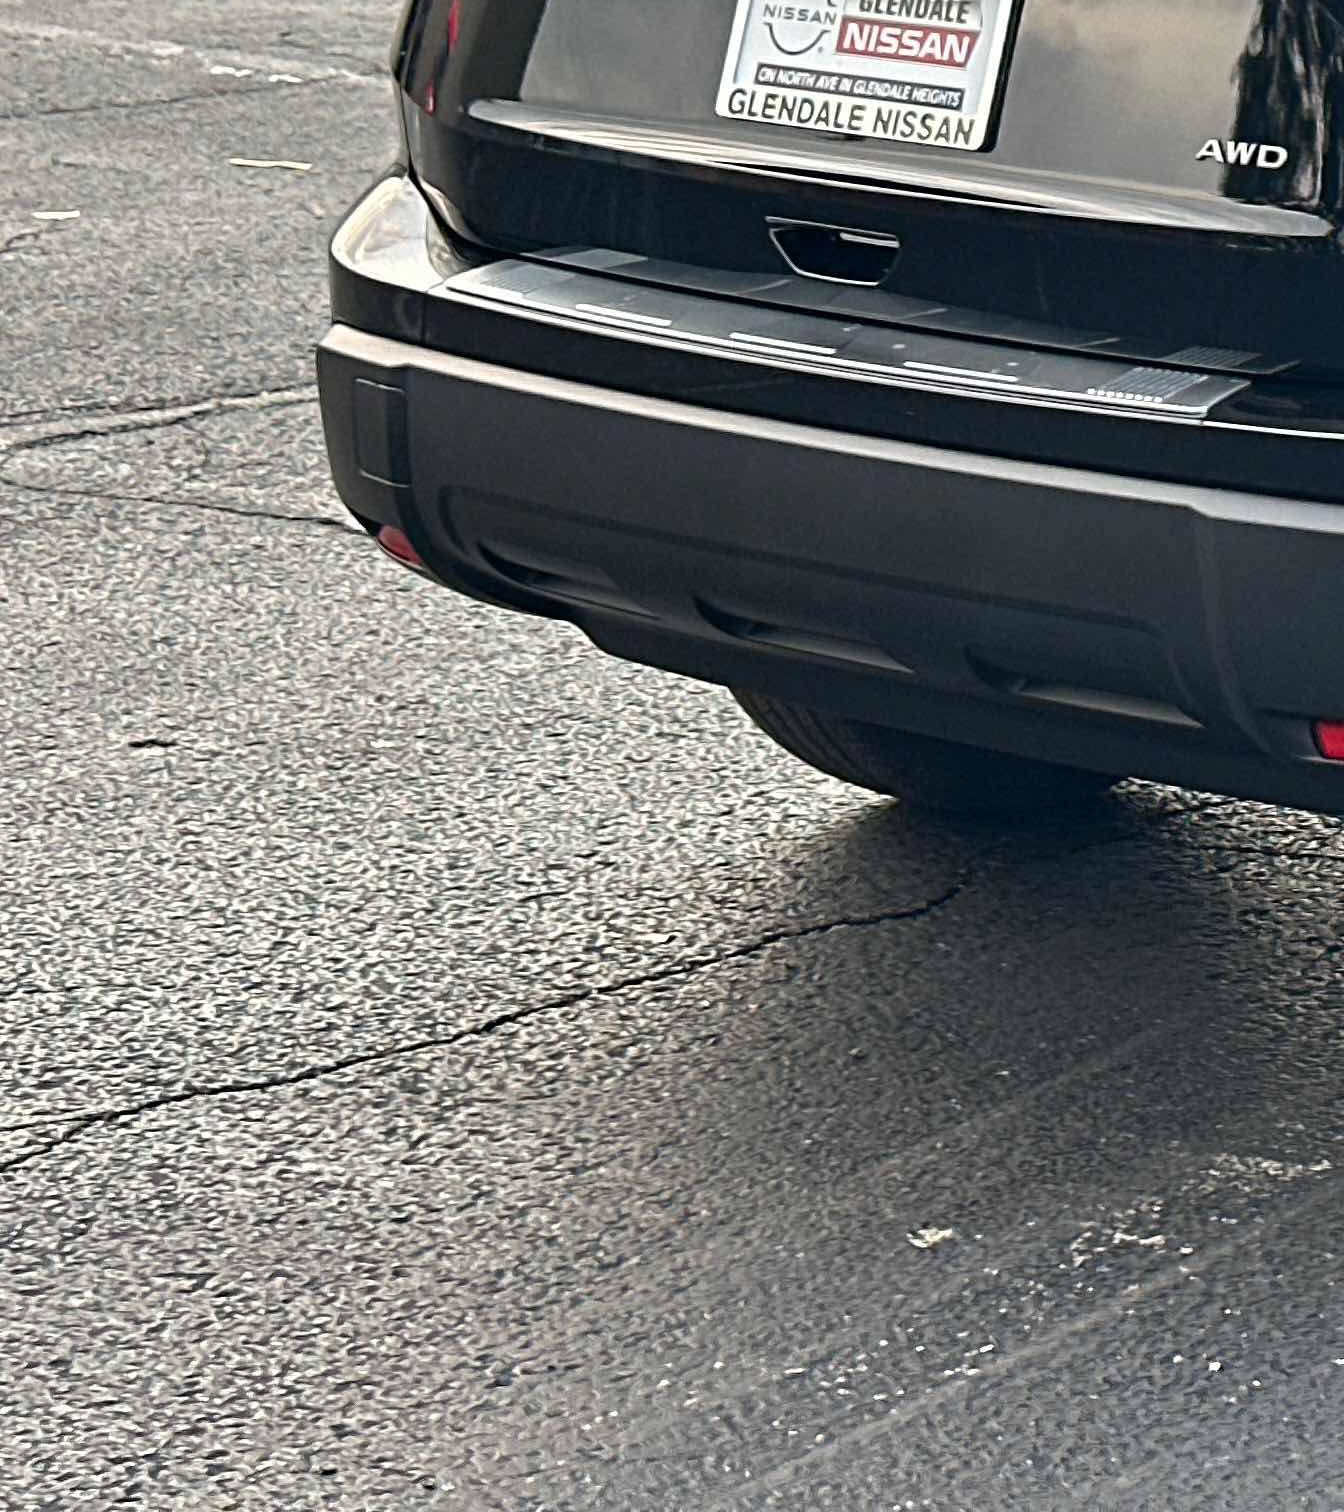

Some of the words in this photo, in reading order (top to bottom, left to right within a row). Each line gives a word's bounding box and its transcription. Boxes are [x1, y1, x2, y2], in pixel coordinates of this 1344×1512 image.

[763, 4, 838, 25] NISSAN
[843, 22, 971, 64] NISSAN
[758, 67, 777, 83] ON
[776, 68, 818, 87] NORTH
[815, 75, 840, 90] AVE
[839, 78, 853, 92] IN
[852, 79, 912, 101] GLENDALE
[911, 87, 961, 107] HEIGHTS
[727, 88, 866, 131] GLENDALE
[873, 107, 976, 146] NISSAN
[1195, 138, 1289, 169] AWD
